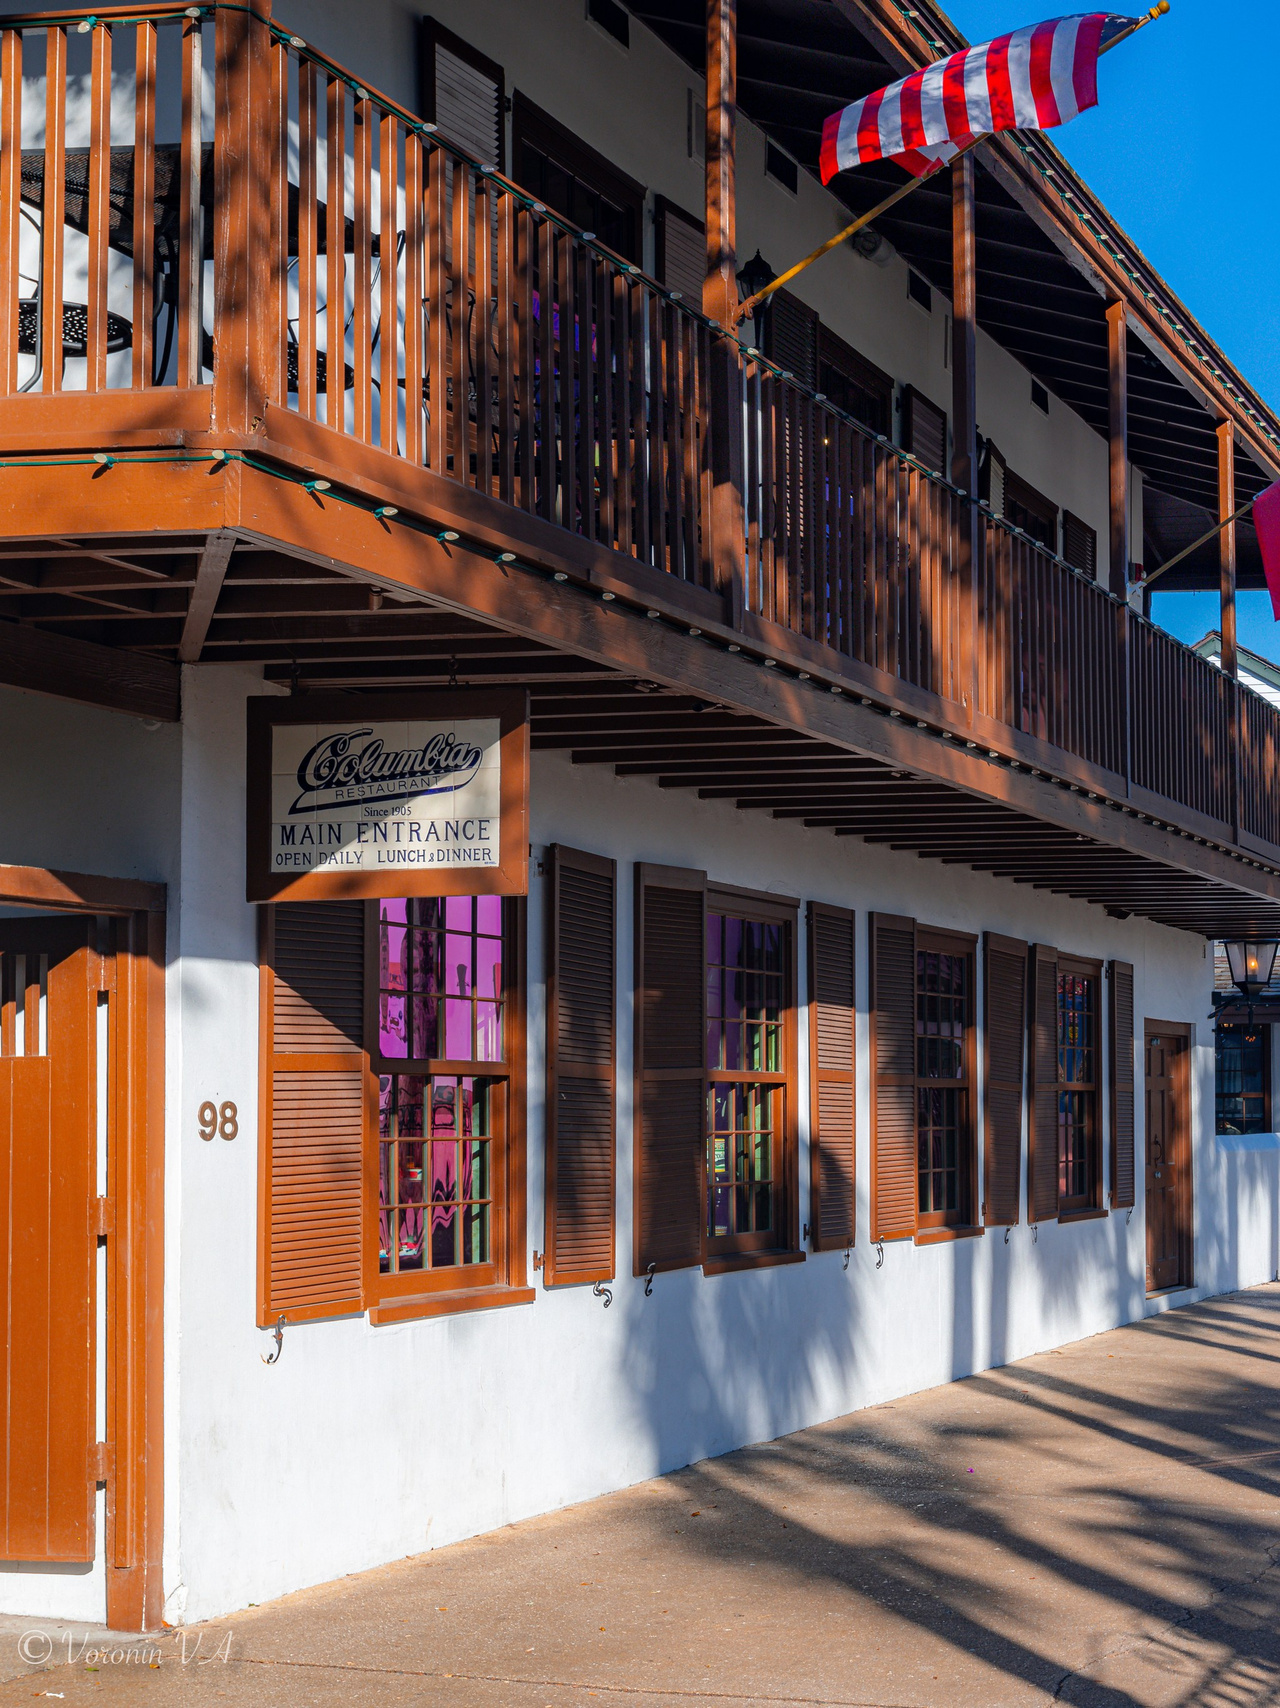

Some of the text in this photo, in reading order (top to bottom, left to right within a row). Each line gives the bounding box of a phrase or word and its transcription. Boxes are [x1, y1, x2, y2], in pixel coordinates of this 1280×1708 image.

[297, 728, 483, 791] Columbia
[335, 775, 441, 800] RESTAURANT
[364, 806, 412, 817] Since 1905
[280, 819, 491, 846] MAIN ENTRANCE
[275, 852, 312, 866] OPEN
[318, 850, 364, 865] DAILY
[198, 1100, 239, 1142] 98
